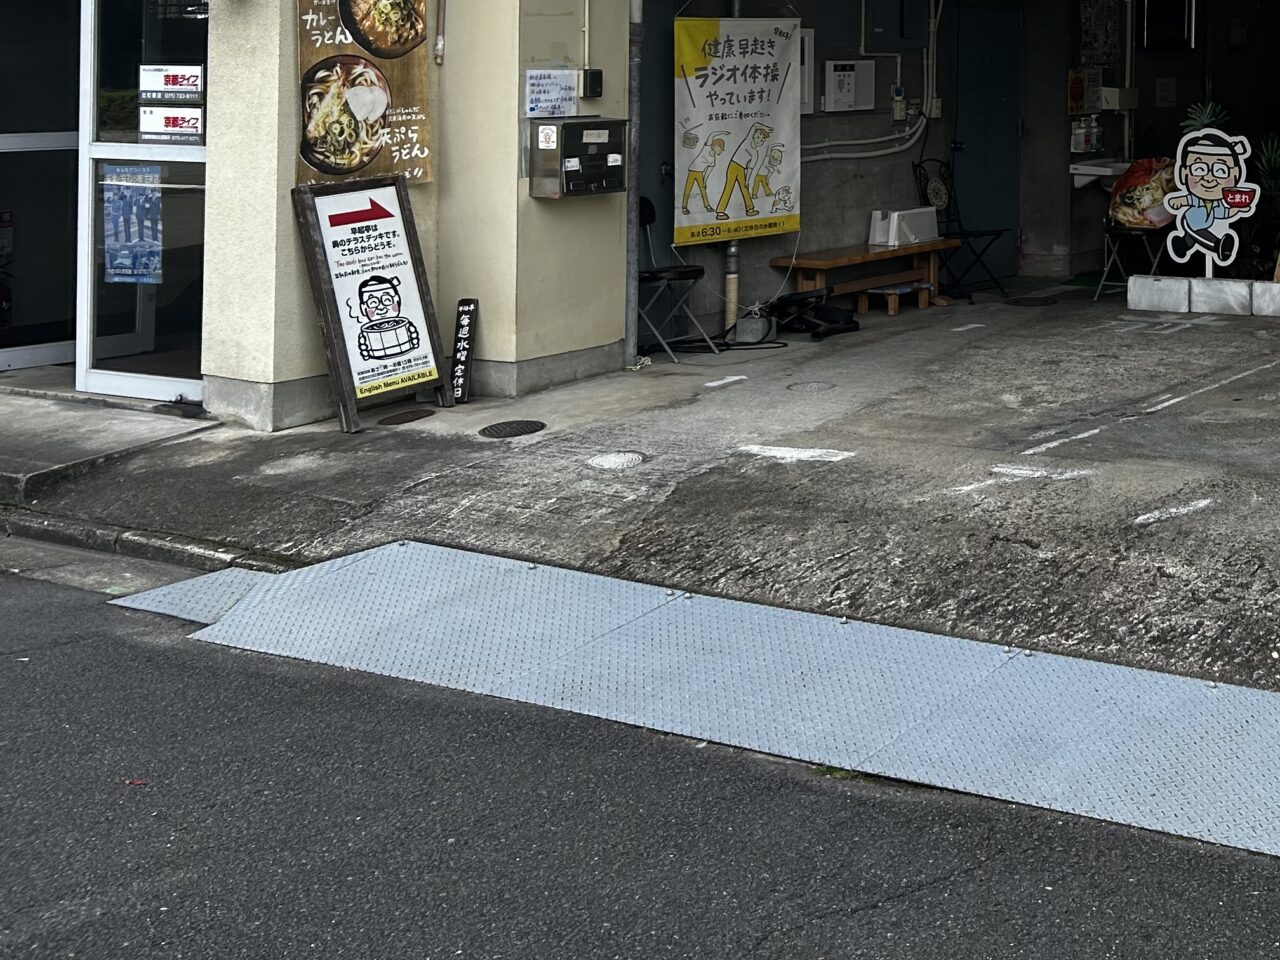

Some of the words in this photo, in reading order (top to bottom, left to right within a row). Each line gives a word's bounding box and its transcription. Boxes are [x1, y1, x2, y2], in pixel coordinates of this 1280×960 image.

[301, 9, 336, 29] カレー
[310, 26, 353, 48] うどん
[701, 34, 776, 60] 健康早起き
[694, 62, 780, 88] ラジオ体操
[706, 87, 771, 107] やっています!
[391, 144, 429, 163] うどん
[1227, 193, 1250, 203] とまれ
[359, 383, 382, 395] English
[383, 379, 400, 389] Menu
[400, 370, 433, 384] AVAILABLE
